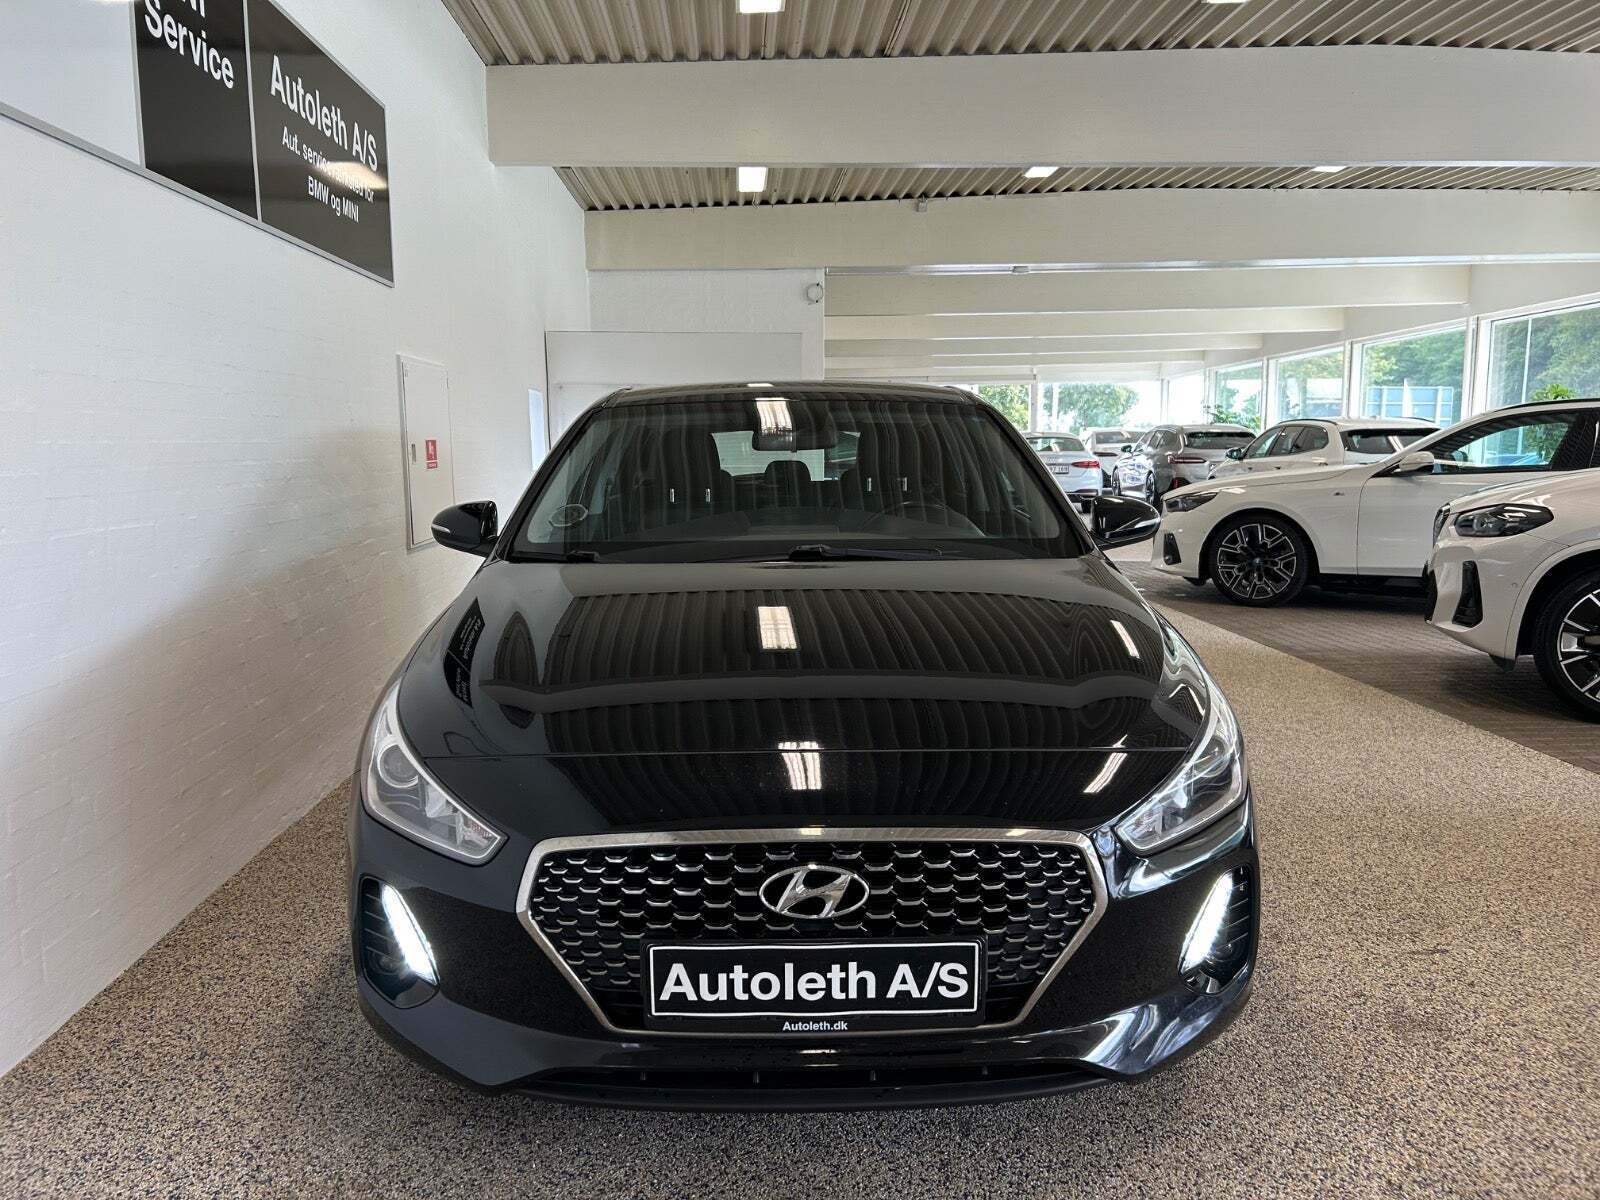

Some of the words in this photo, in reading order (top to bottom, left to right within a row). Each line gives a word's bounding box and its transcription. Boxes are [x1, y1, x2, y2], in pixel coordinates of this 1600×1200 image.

[145, 0, 234, 89] Service
[270, 54, 348, 151] Autoleth
[352, 121, 378, 171] A/S
[282, 126, 301, 156] Aut.
[308, 175, 329, 205] BMW
[330, 194, 341, 217] og
[342, 197, 359, 222] MINI
[659, 961, 877, 1001] Autoleth
[886, 961, 969, 999] A/S
[782, 1020, 849, 1031] Autoleth.dk
